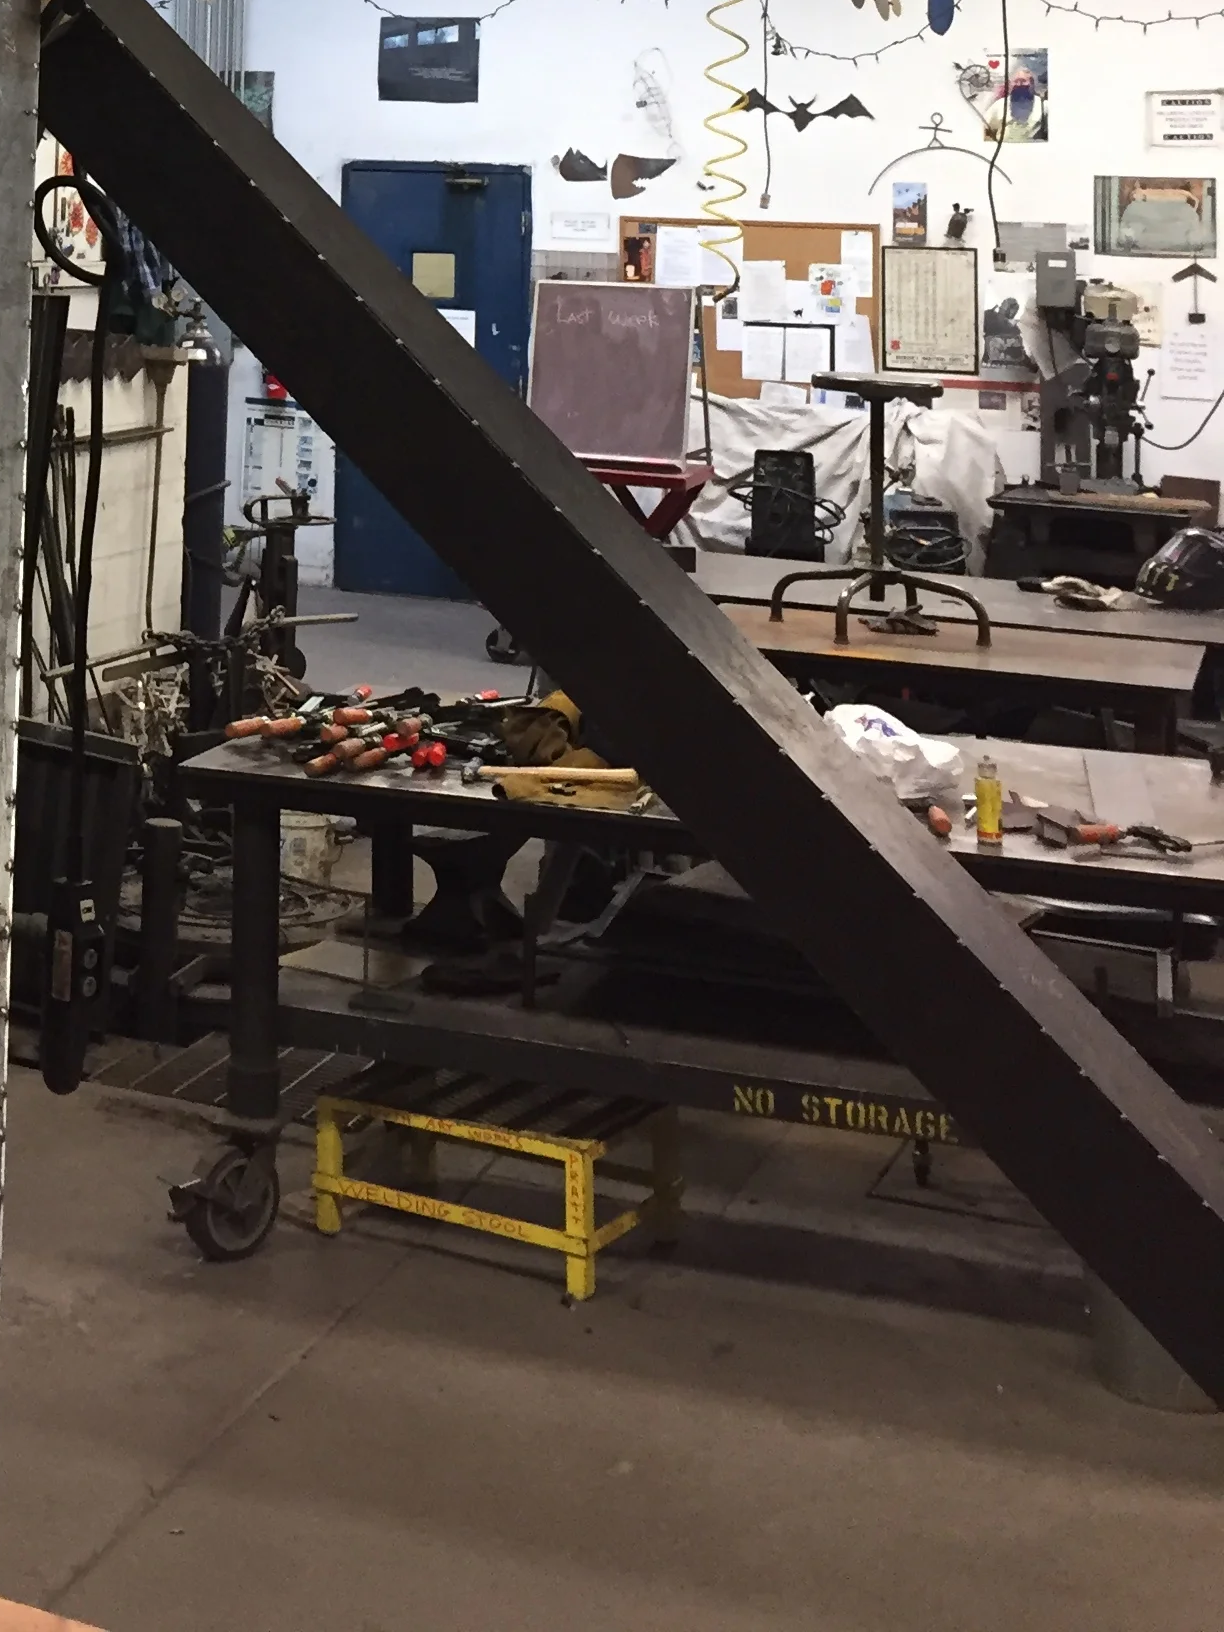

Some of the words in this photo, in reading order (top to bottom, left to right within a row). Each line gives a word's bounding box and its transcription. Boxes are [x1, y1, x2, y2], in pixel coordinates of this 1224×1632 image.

[733, 1084, 775, 1116] NO
[801, 1093, 959, 1144] STORAGE
[338, 1178, 451, 1217] WELDING
[462, 1210, 530, 1237] STOOL
